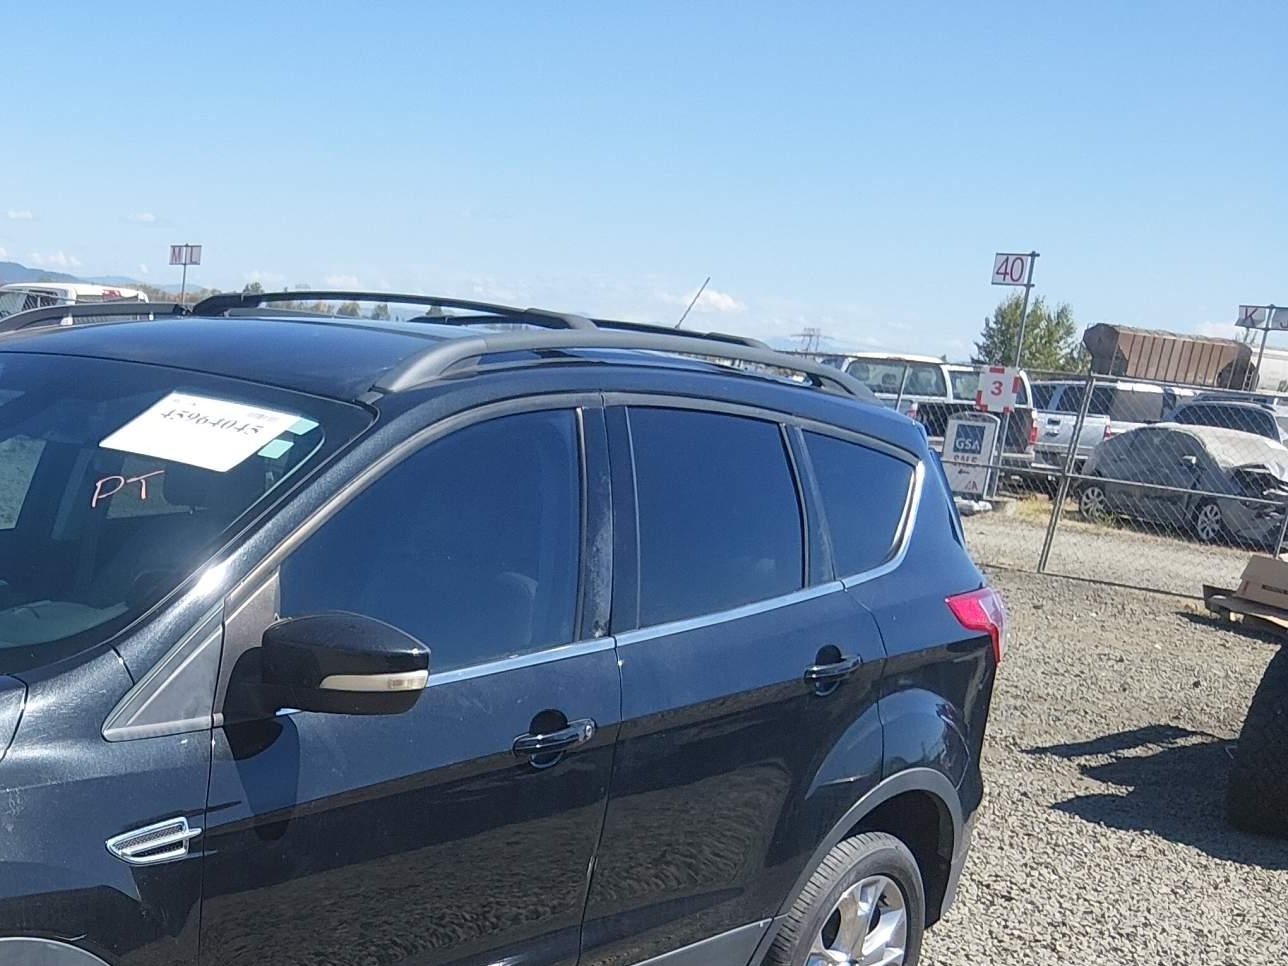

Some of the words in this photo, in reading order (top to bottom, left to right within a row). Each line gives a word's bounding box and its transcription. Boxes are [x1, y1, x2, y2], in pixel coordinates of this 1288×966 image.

[190, 247, 198, 264] L
[995, 256, 1025, 282] 40
[1245, 307, 1259, 327] K
[990, 380, 1004, 396] 3
[955, 437, 980, 451] GSA
[92, 469, 165, 508] PT
